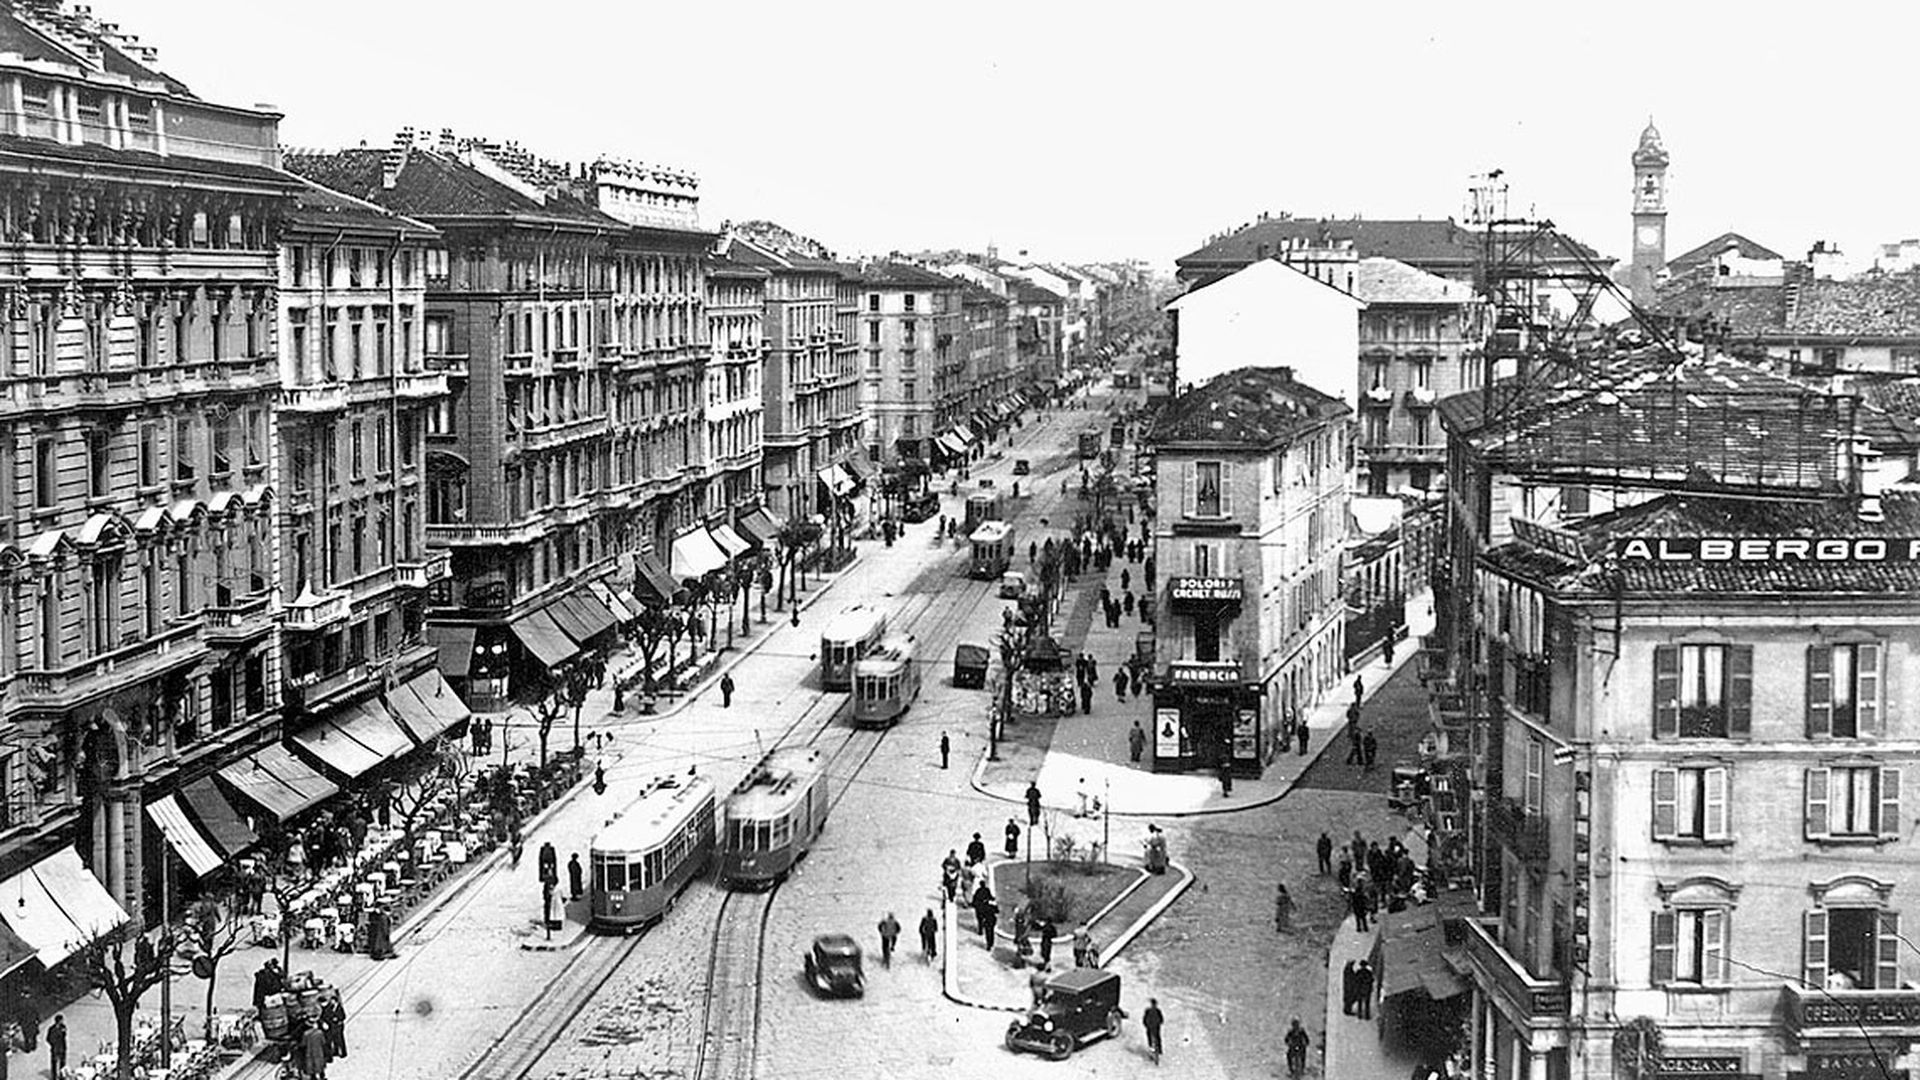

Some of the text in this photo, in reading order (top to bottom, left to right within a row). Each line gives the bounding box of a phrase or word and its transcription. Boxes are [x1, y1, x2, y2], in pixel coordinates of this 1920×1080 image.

[1624, 540, 1886, 560] ALBERGO
[1175, 670, 1238, 681] FARMACIA
[1805, 1005, 1860, 1021] CREDITO
[1660, 1060, 1710, 1071] AGENZIA
[1820, 1058, 1877, 1069] BANCA
